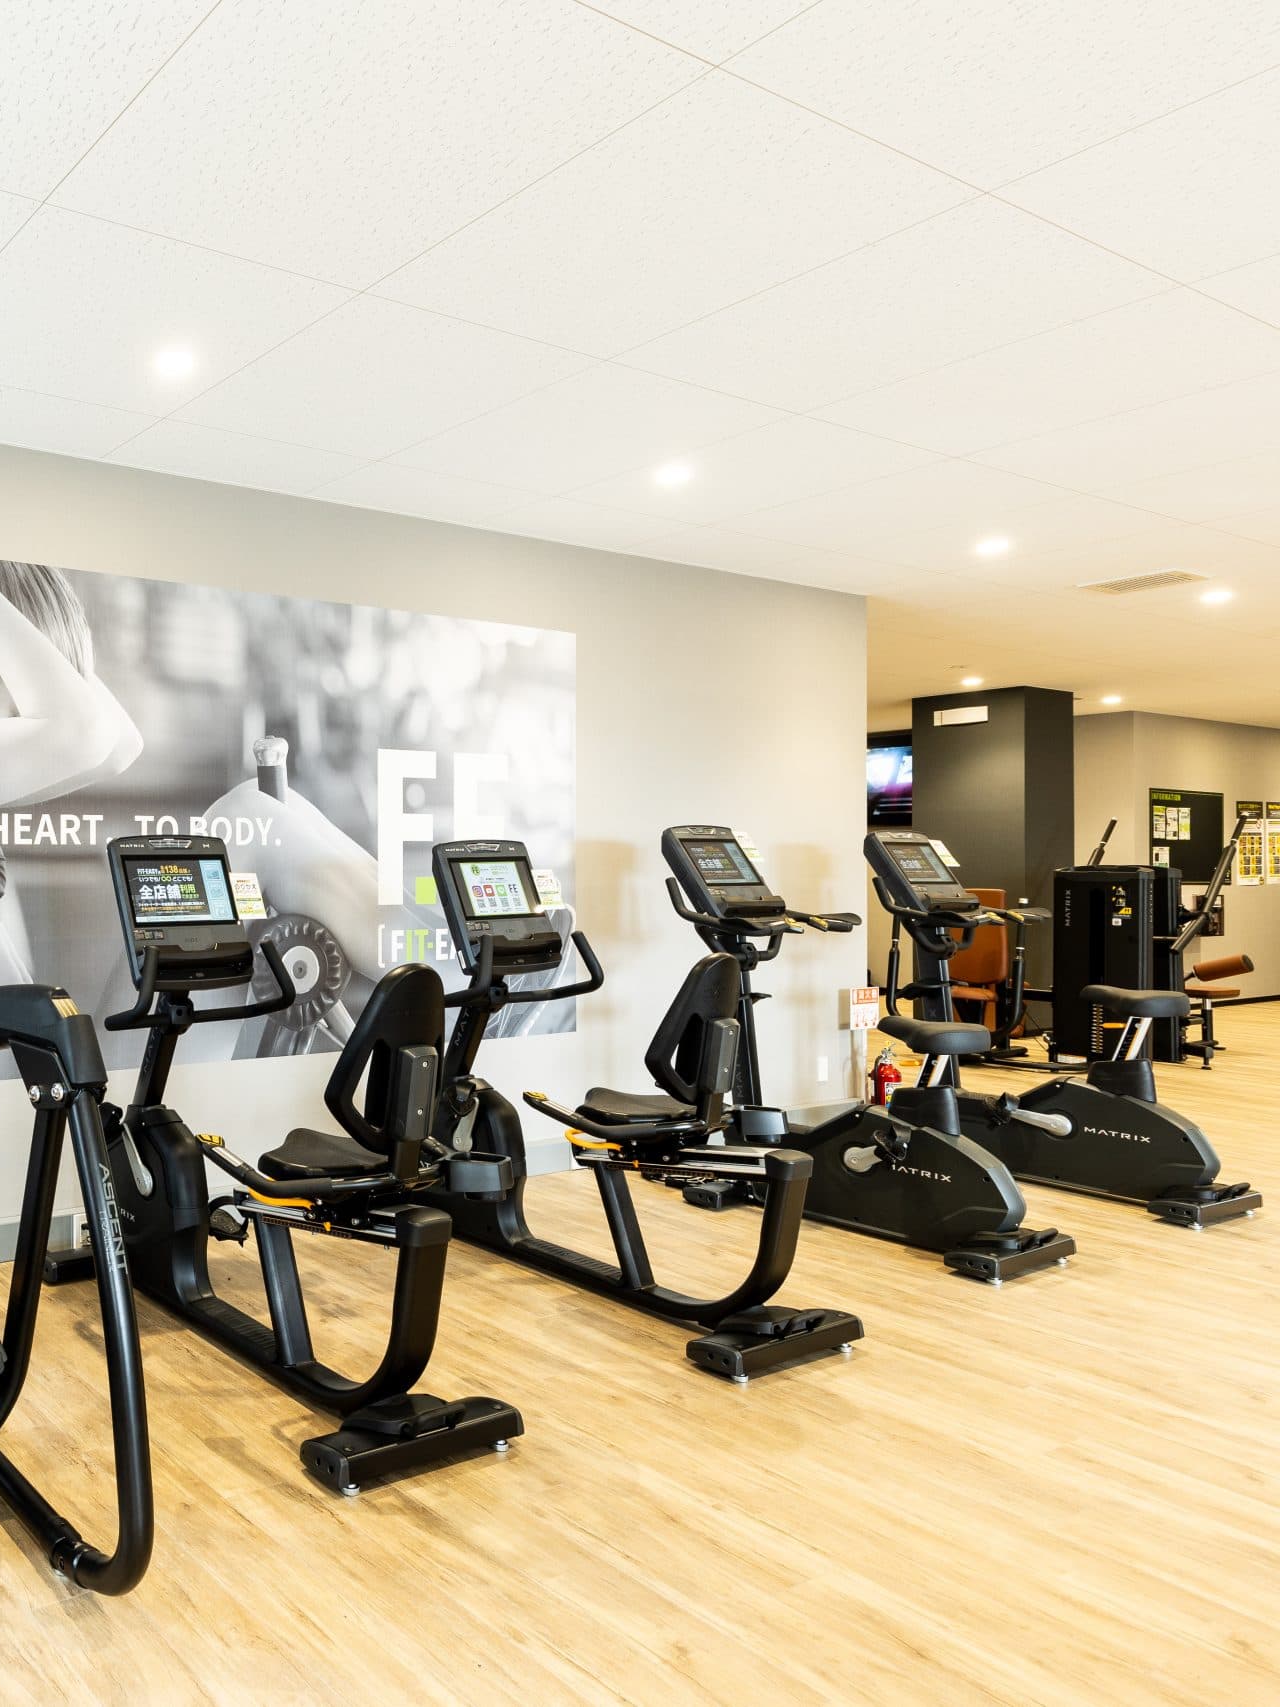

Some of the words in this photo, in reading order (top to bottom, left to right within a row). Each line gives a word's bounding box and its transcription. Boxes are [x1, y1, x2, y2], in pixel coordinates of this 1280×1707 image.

[134, 815, 179, 836] TO
[189, 816, 282, 848] BODY.
[1083, 1126, 1151, 1143] MATRIX
[99, 1163, 128, 1275] ASCENT
[120, 1207, 136, 1223] RIX
